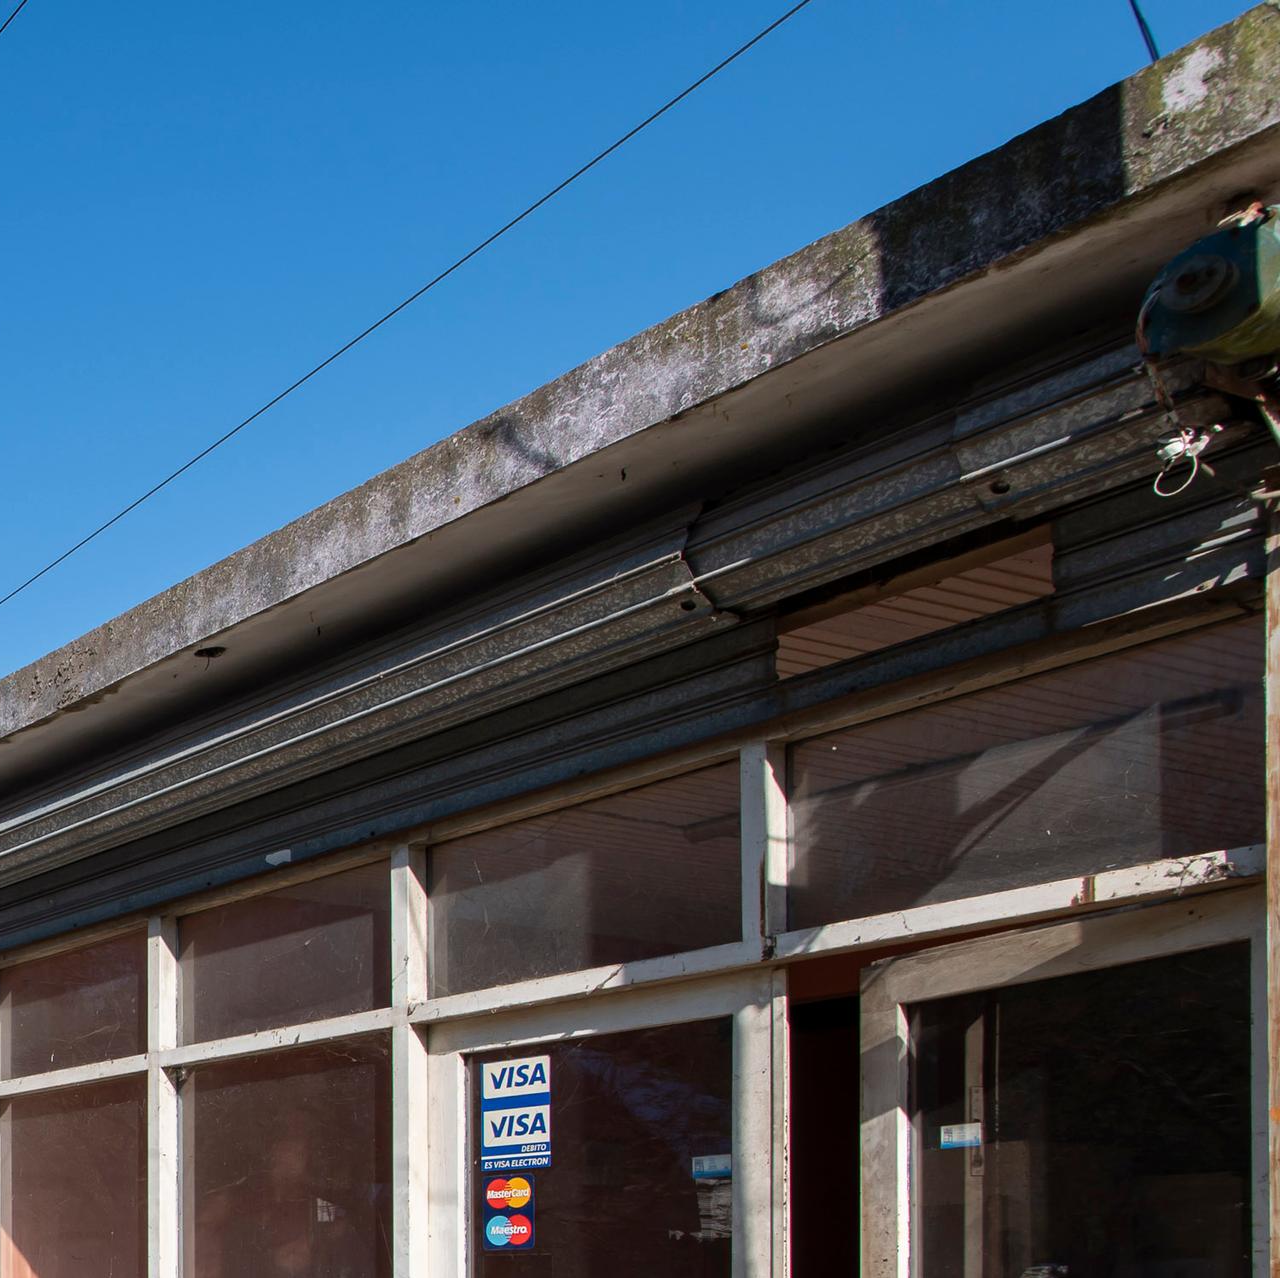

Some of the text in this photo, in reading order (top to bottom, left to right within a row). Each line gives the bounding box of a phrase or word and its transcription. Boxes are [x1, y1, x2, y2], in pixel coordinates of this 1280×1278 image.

[490, 1062, 547, 1090] VISA
[490, 1112, 547, 1139] VISA
[521, 1144, 547, 1153] DEBITO
[484, 1156, 549, 1169] ES VISA ELECTRON
[486, 1186, 530, 1200] MasterCard
